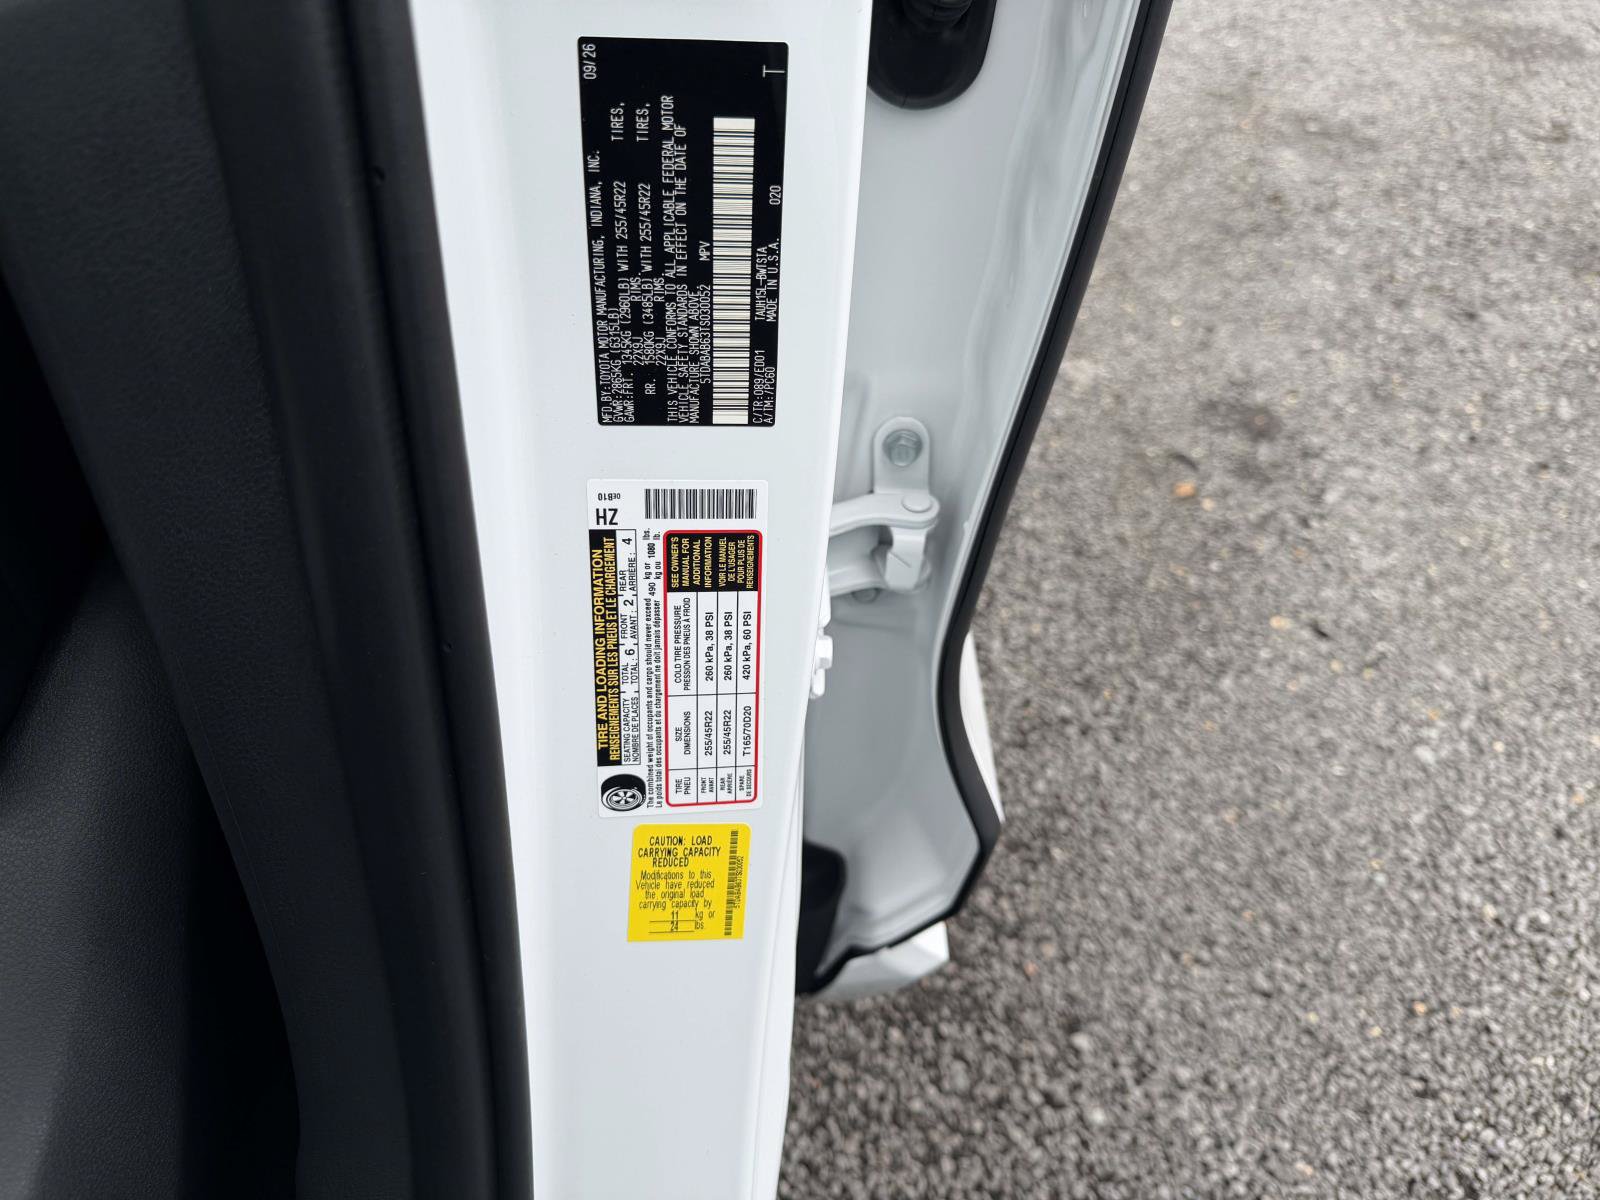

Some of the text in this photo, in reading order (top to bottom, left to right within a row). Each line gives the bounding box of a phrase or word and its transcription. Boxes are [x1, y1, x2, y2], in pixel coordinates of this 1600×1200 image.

[762, 65, 785, 77] T
[610, 102, 625, 141] TIRES,
[587, 150, 600, 172] INC.
[590, 182, 603, 226] INDIANA,
[613, 181, 628, 239] 255/45R22
[616, 246, 628, 271] WITH
[636, 103, 656, 394] RR. 1580KG (3485LB) WITH 255/45R22 TIRES,
[661, 95, 678, 422] THIS VEHICLE CONFORMS TO ALL APPLICABLE FEDERAL MOTOR
[699, 241, 710, 261] MPV
[768, 238, 779, 273] U.S.A.
[592, 235, 606, 315] MANUFACTURING,
[674, 123, 689, 423] VEHICLE SAFETY STANDARDS IN EFFECT ON THE DATE OF
[767, 280, 778, 289] IN
[618, 278, 631, 323] (2960LB)
[766, 298, 777, 322] MADE
[596, 320, 608, 348] MOTOR
[608, 308, 620, 353] (6315LB)
[630, 272, 644, 366] 22X9J RIMS.
[654, 273, 666, 366] 22X9J RIMS.
[621, 331, 632, 364] 1345KG
[689, 286, 699, 423] MANUFACTURE SHOWN ABOVE.
[592, 550, 608, 750] TIRE AND LOADING INFORMATION
[604, 537, 620, 760] RENSEIGNEMENTS SUR LES PNEUS ET LE CHARGEMENT
[706, 631, 713, 640] 38
[724, 630, 732, 640] 38
[743, 630, 751, 640] 60
[705, 644, 715, 663] kPa,
[724, 643, 733, 662] kPa,
[743, 643, 752, 662] kPa,
[632, 724, 638, 732] DE
[646, 700, 655, 732] occupants
[743, 706, 751, 756] T165/70D20
[646, 742, 655, 762] weight
[638, 846, 721, 857] CARRYING CAPACITY
[692, 836, 712, 846] LOAD
[653, 857, 689, 867] REDUCED
